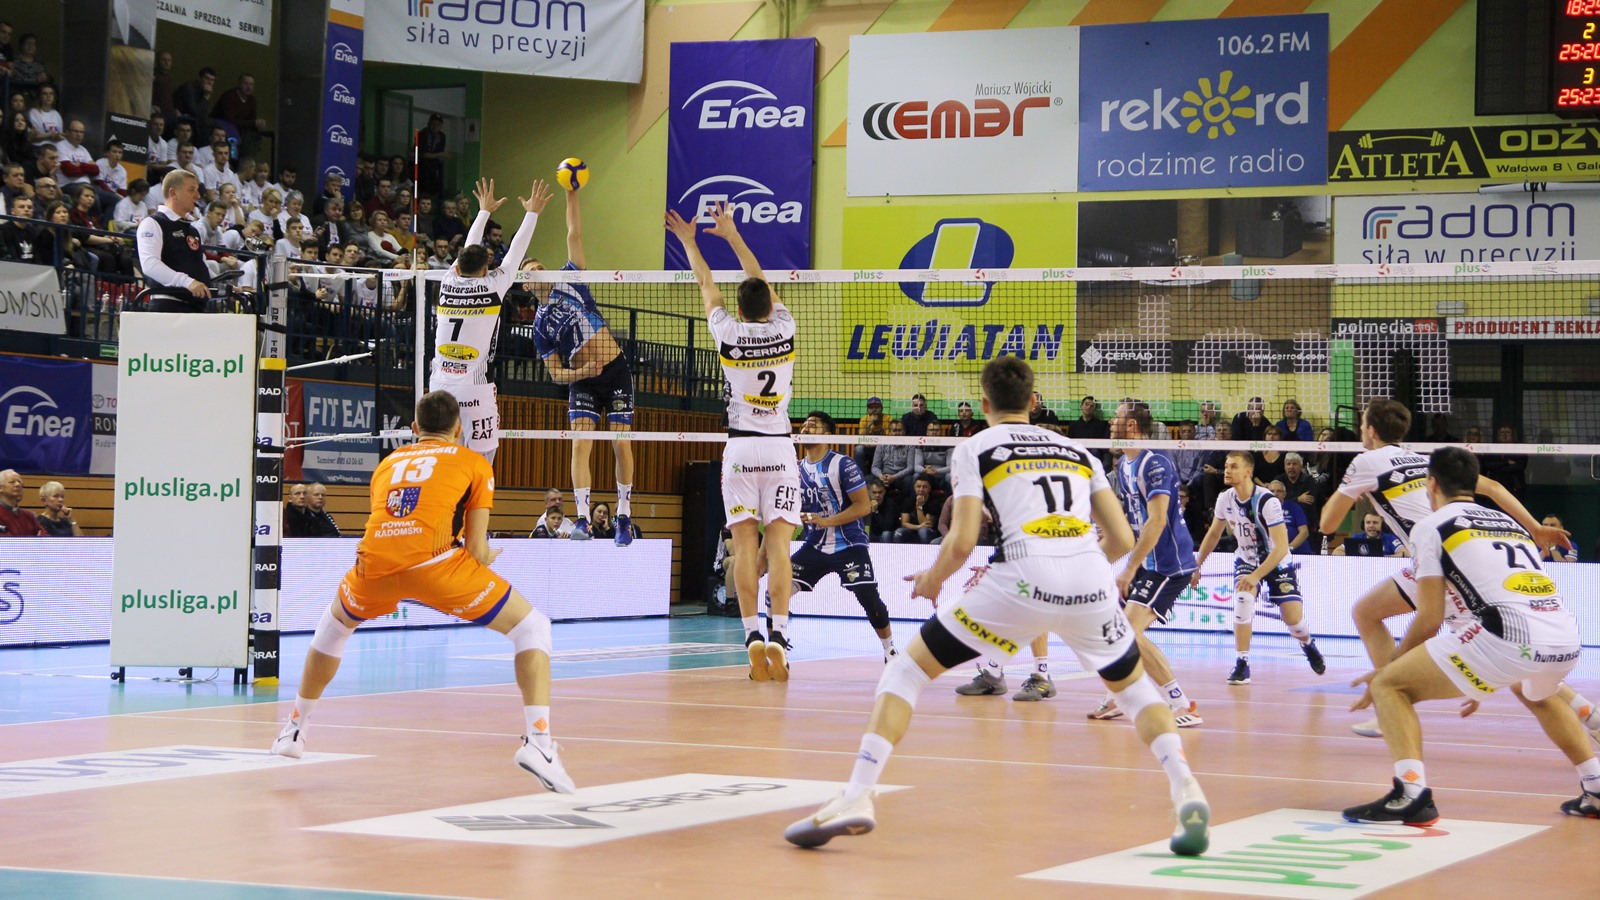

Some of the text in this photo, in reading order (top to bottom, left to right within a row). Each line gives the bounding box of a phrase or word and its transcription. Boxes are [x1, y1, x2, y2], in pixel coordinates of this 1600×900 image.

[193, 9, 232, 28] SPRZEDAŻ
[238, 21, 265, 36] SERWIS
[1583, 22, 1596, 39] 2
[406, 22, 586, 61] siła w precyzji
[1217, 31, 1310, 56] 106.2 FM
[334, 49, 358, 65] Enea
[1582, 67, 1595, 84] 3
[975, 80, 1052, 97] Mariusz Wójcicki
[333, 90, 355, 105] Enea
[698, 99, 805, 129] Enea
[330, 131, 353, 146] Enea
[1097, 148, 1305, 177] rodzime radio
[1329, 140, 1473, 179] ATLETA
[1496, 163, 1548, 173] Wałowa
[1553, 162, 1562, 171] 8
[696, 193, 803, 224] Enea
[1363, 202, 1575, 239] radom
[1425, 249, 1445, 264] w
[674, 271, 695, 281] plus
[853, 270, 875, 281] plus
[1042, 269, 1065, 280] plus
[1242, 267, 1266, 278] plus
[1454, 263, 1480, 276] plus
[446, 297, 492, 306] CERRAD
[448, 318, 464, 342] 7
[1338, 319, 1413, 336] polmedia
[1454, 320, 1550, 334] PRODUCENT
[736, 332, 783, 345] OSTROWSKI
[847, 319, 1065, 361] LEWIATAN
[744, 343, 791, 358] CERRAD
[1105, 352, 1153, 361] CERRAD
[1247, 352, 1326, 361] www.cerrad.com
[128, 353, 244, 377] plusliga.pl
[747, 356, 790, 368] LEWIATAN
[757, 370, 778, 397] 2
[308, 396, 339, 427] FIT
[343, 399, 376, 429] EAT
[5, 405, 76, 438] Enea
[471, 416, 493, 430] FIT
[471, 428, 493, 440] EAT
[857, 436, 874, 444] plus
[1112, 440, 1128, 448] plus
[1250, 441, 1267, 449] plus
[1537, 444, 1555, 453] plus
[1012, 445, 1081, 461] CERRAD
[390, 456, 438, 485] 13
[742, 463, 786, 473] humansoft
[1023, 461, 1079, 472] LEWIATAN
[124, 477, 240, 502] plusliga.pl
[776, 485, 797, 500] FIT
[1032, 475, 1073, 514] 17
[774, 498, 795, 512] EAT
[381, 519, 417, 529] POWIAT
[374, 527, 423, 538] RADOMSKI
[1492, 541, 1542, 570] 21
[121, 589, 238, 614] plusliga.pl
[1033, 586, 1108, 606] humansoft
